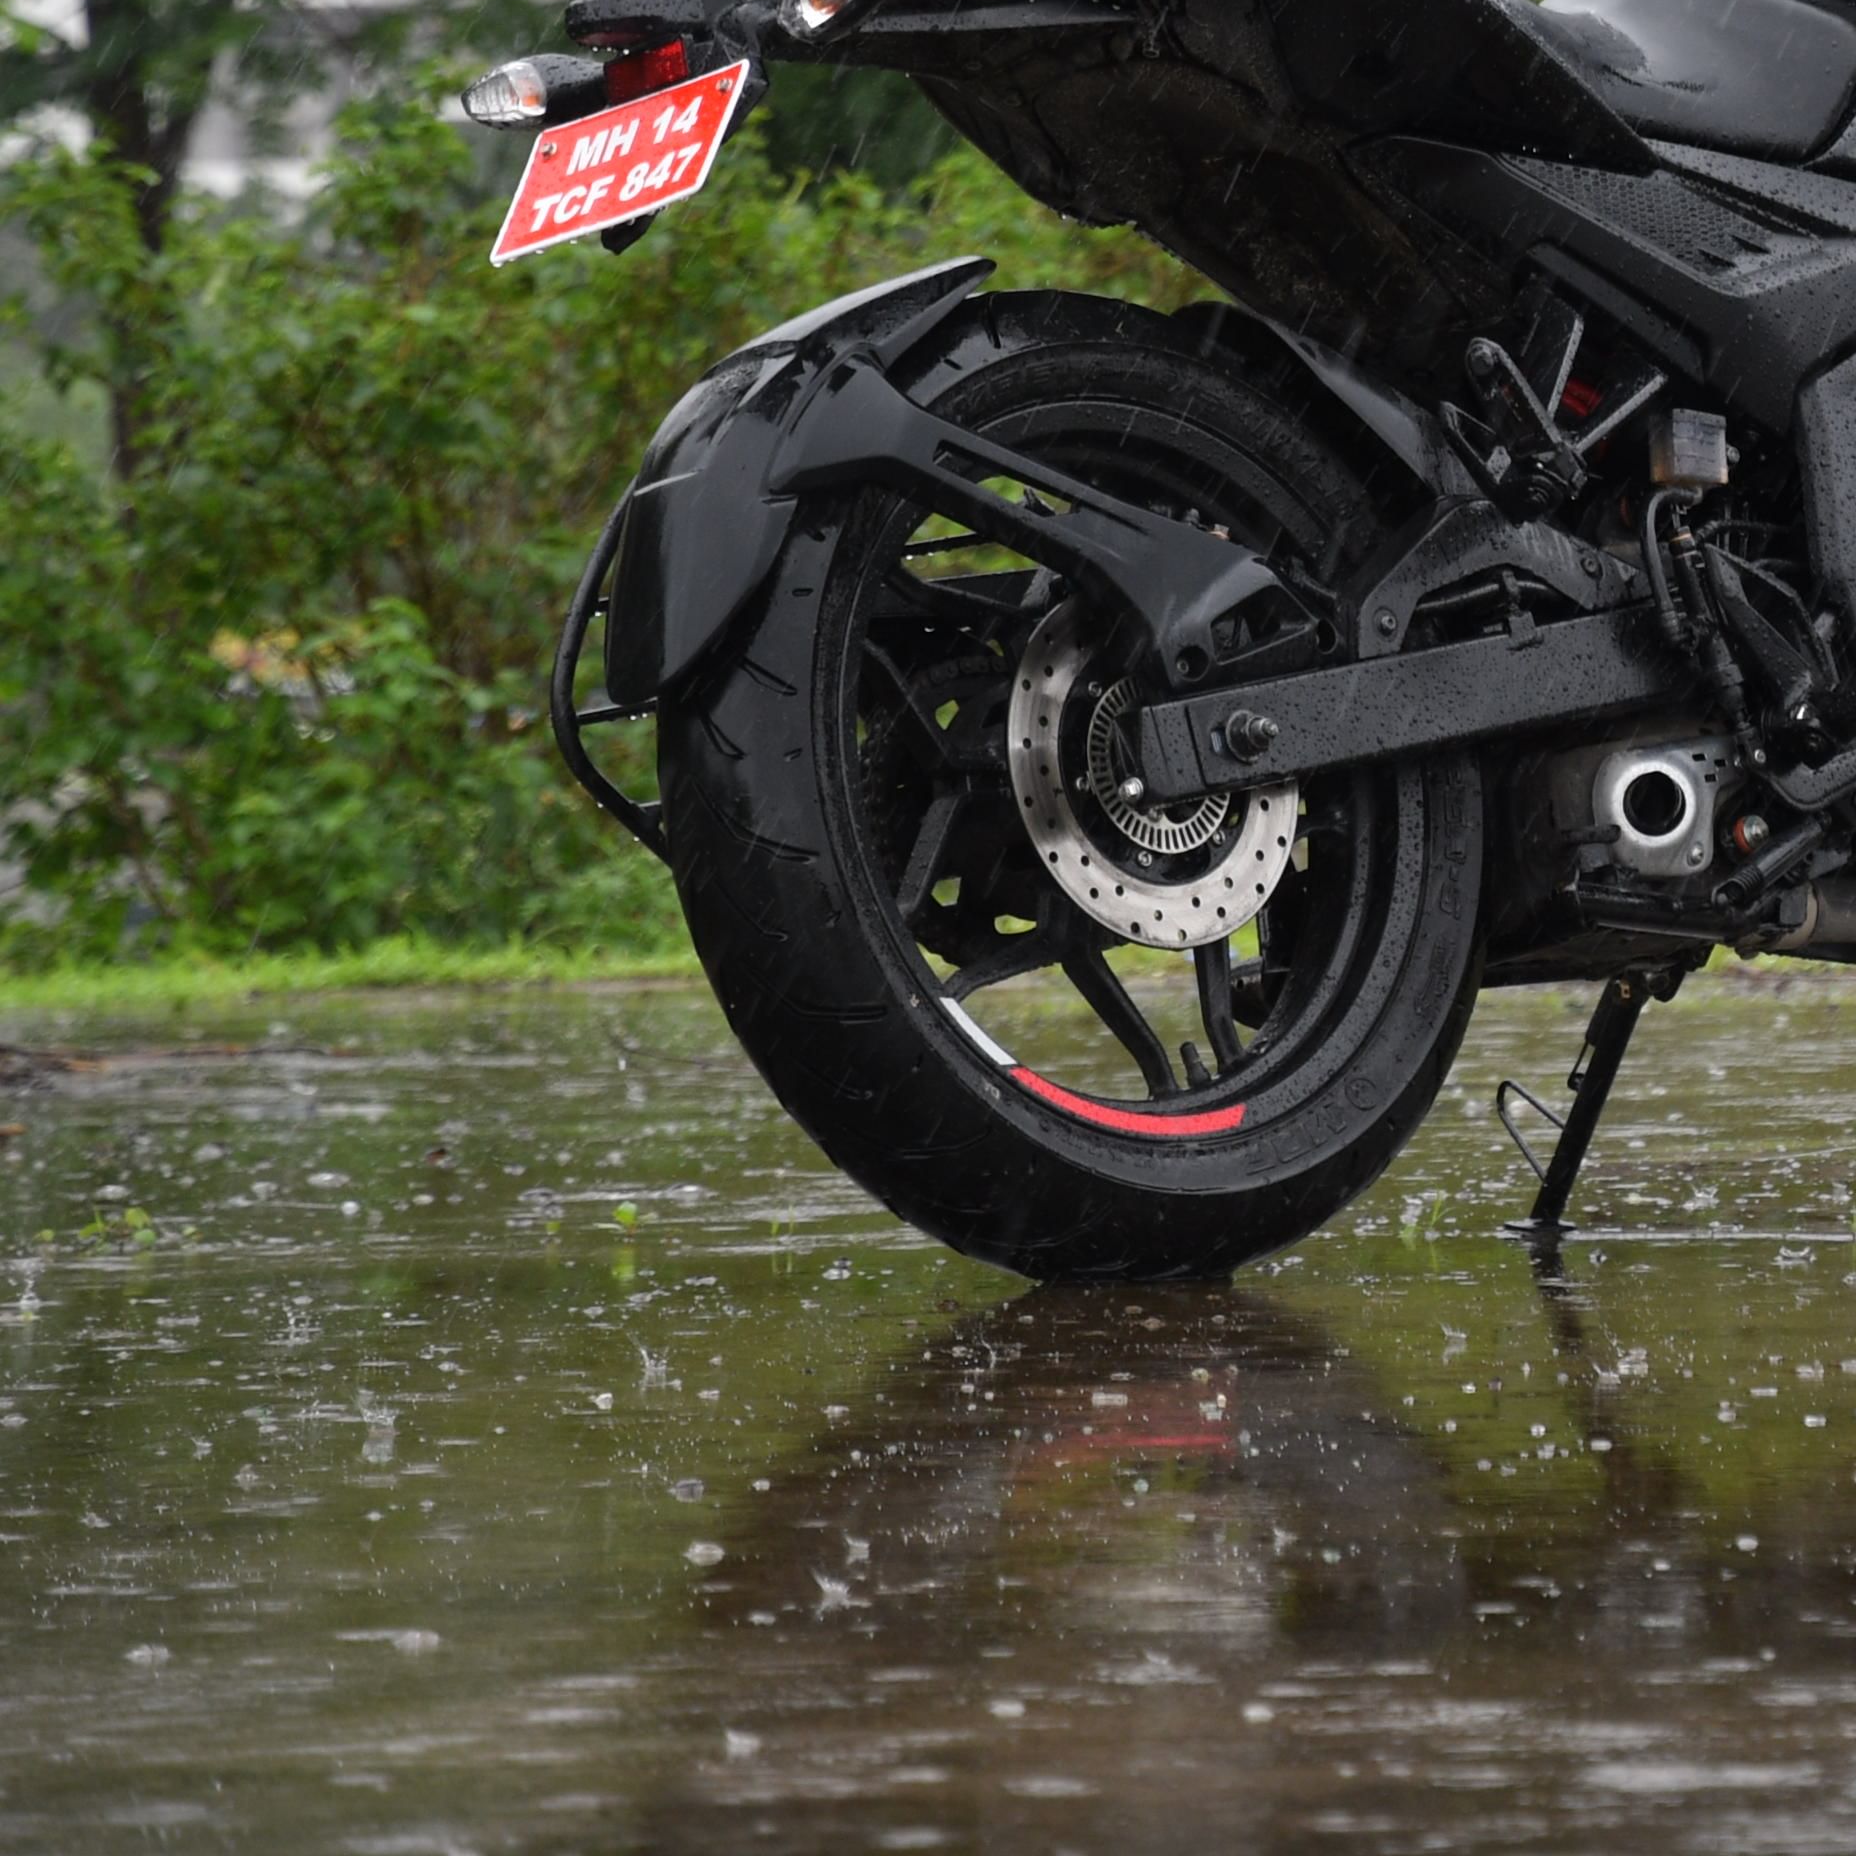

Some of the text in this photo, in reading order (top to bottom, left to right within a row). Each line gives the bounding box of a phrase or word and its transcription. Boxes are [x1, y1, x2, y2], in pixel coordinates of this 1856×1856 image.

[566, 96, 704, 175] MH 14
[530, 142, 702, 232] TCF 847
